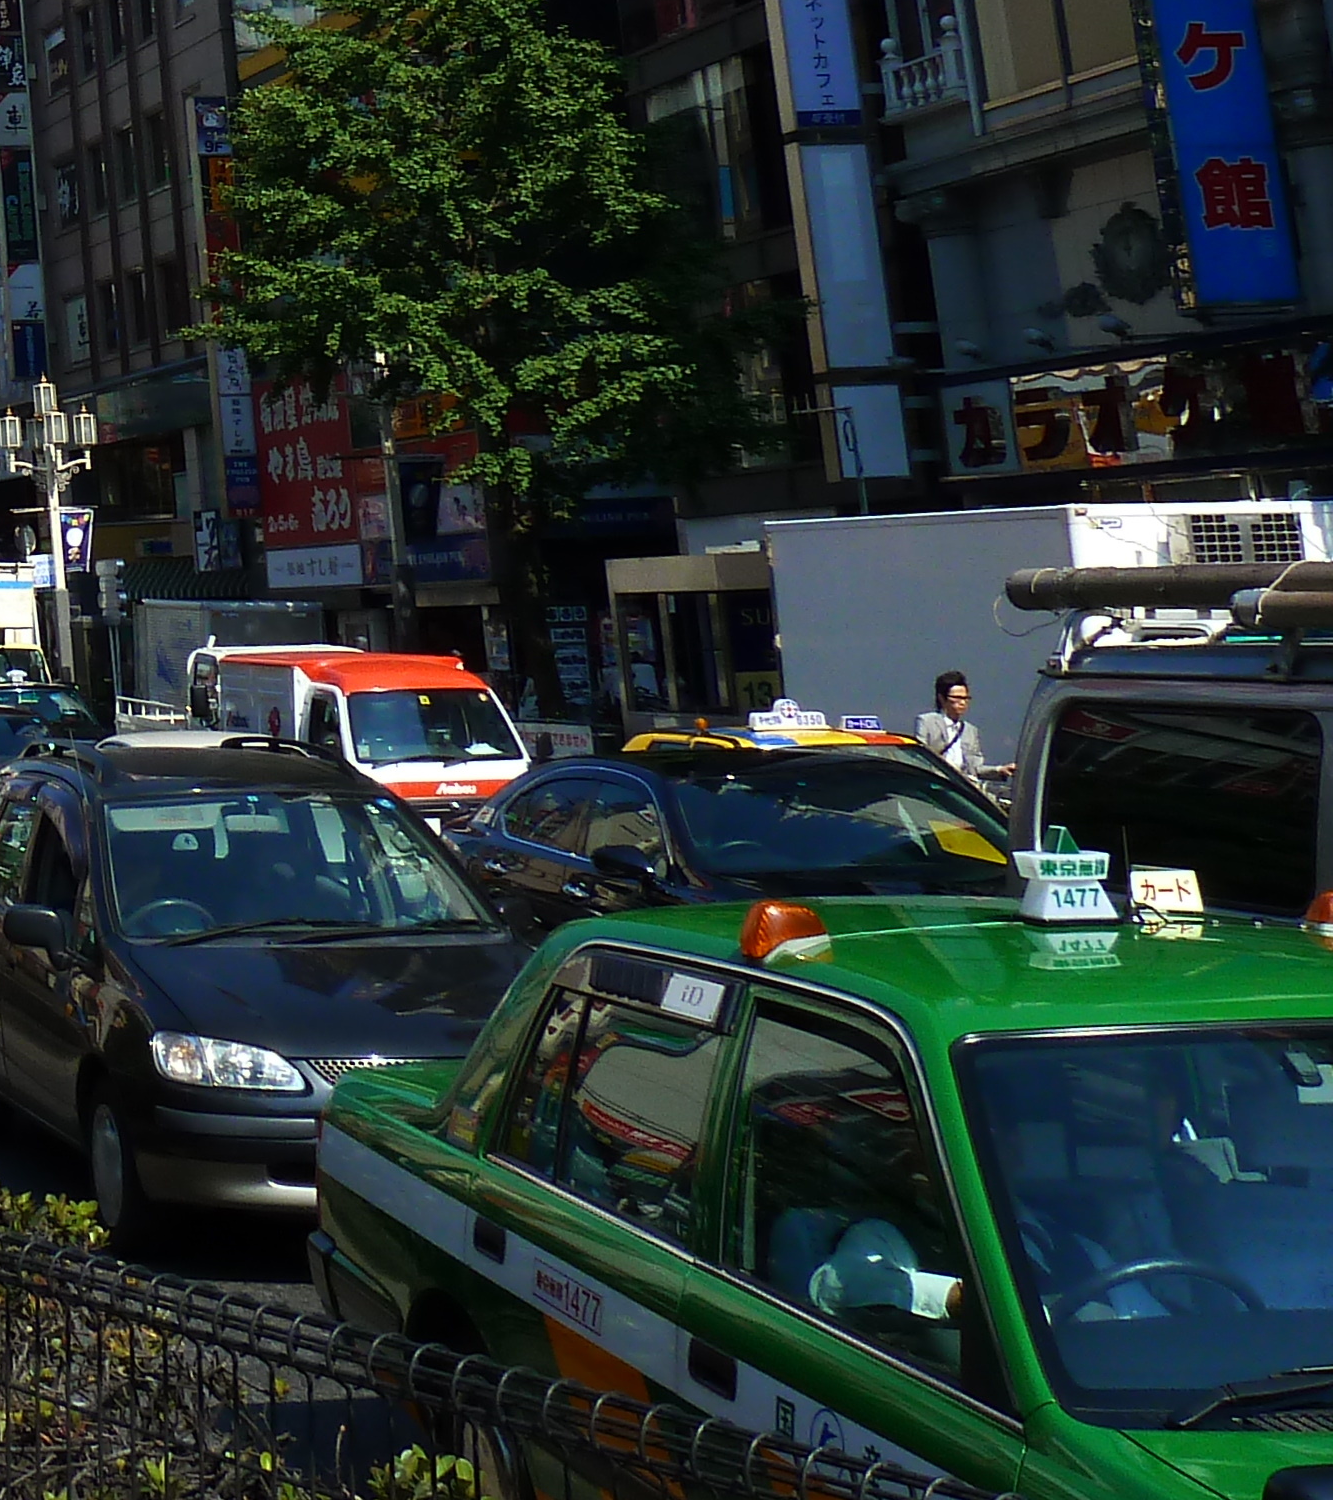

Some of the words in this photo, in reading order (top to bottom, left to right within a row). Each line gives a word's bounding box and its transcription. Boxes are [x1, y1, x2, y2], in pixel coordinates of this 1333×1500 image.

[204, 140, 224, 154] 9F
[743, 681, 773, 707] 13
[1039, 859, 1107, 877] 東京無線
[1050, 887, 1102, 908] 1477
[1140, 878, 1192, 903] カード
[680, 985, 704, 1007] iD
[564, 1280, 602, 1329] 1477
